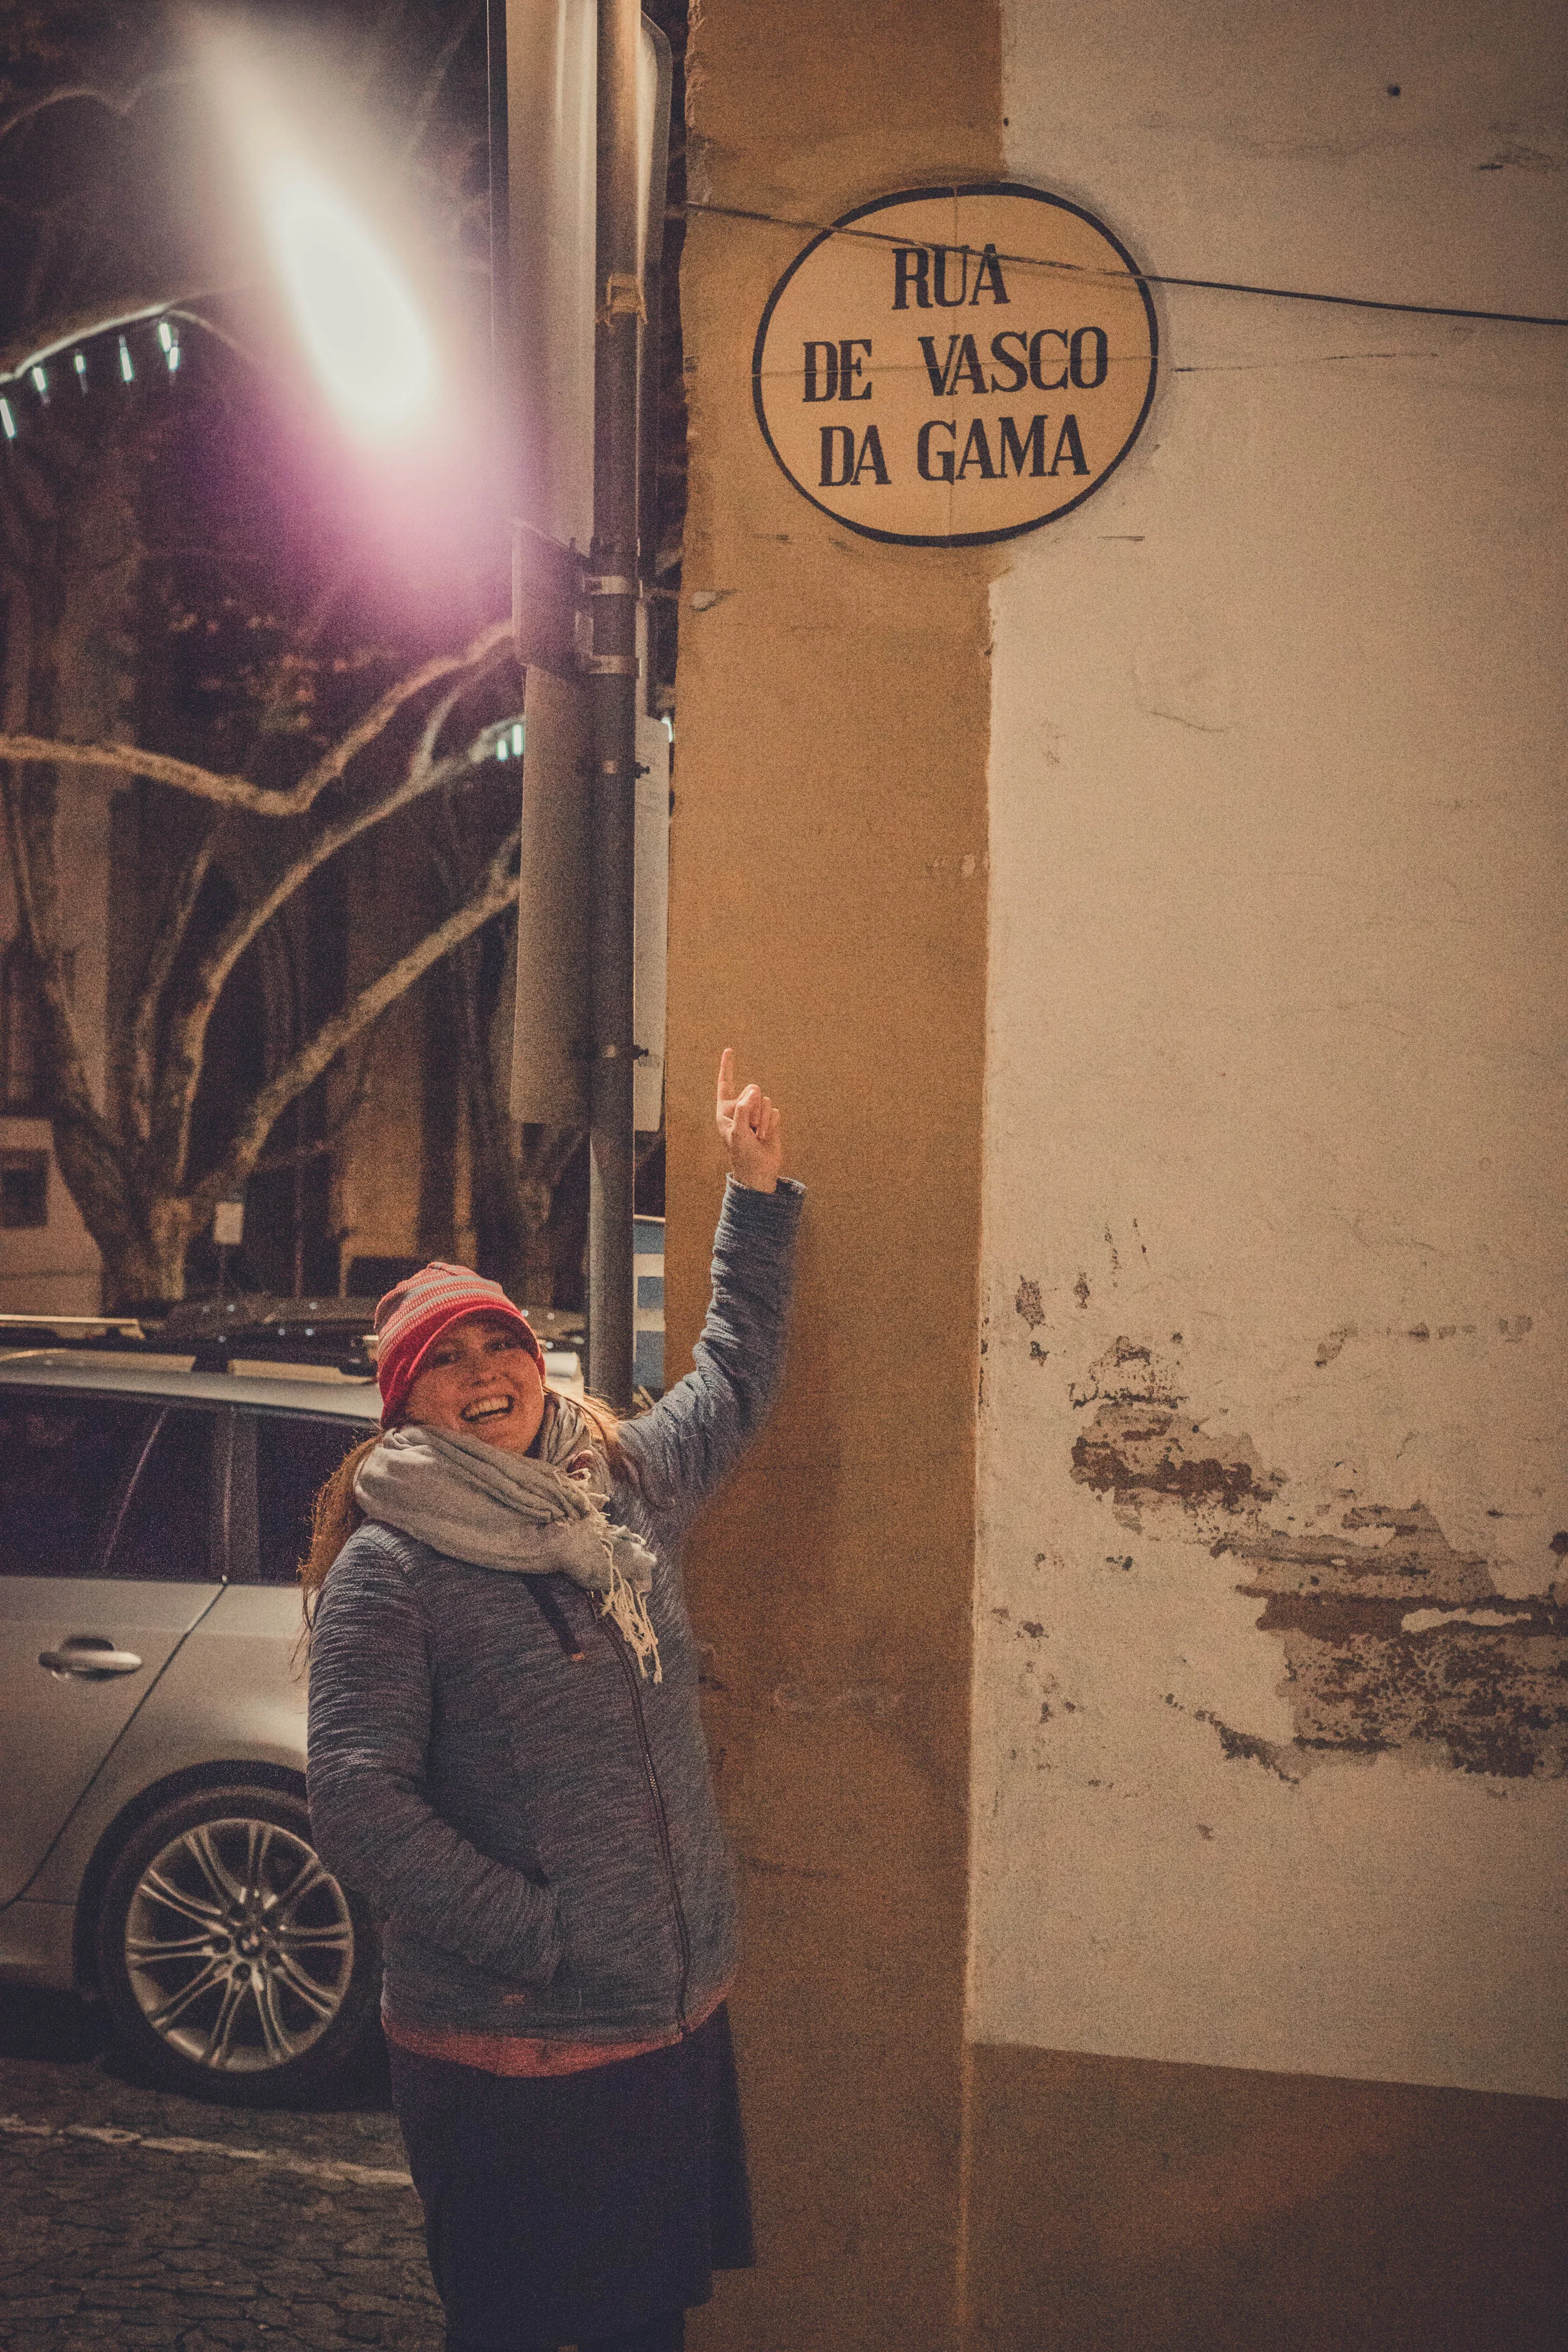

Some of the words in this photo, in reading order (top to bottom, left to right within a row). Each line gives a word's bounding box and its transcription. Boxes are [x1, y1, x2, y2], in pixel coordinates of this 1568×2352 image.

[891, 243, 1010, 310] RUA
[802, 339, 872, 403] DE
[918, 326, 1108, 396] VASCO
[818, 425, 891, 486] DA
[917, 414, 1090, 485] GAMA
